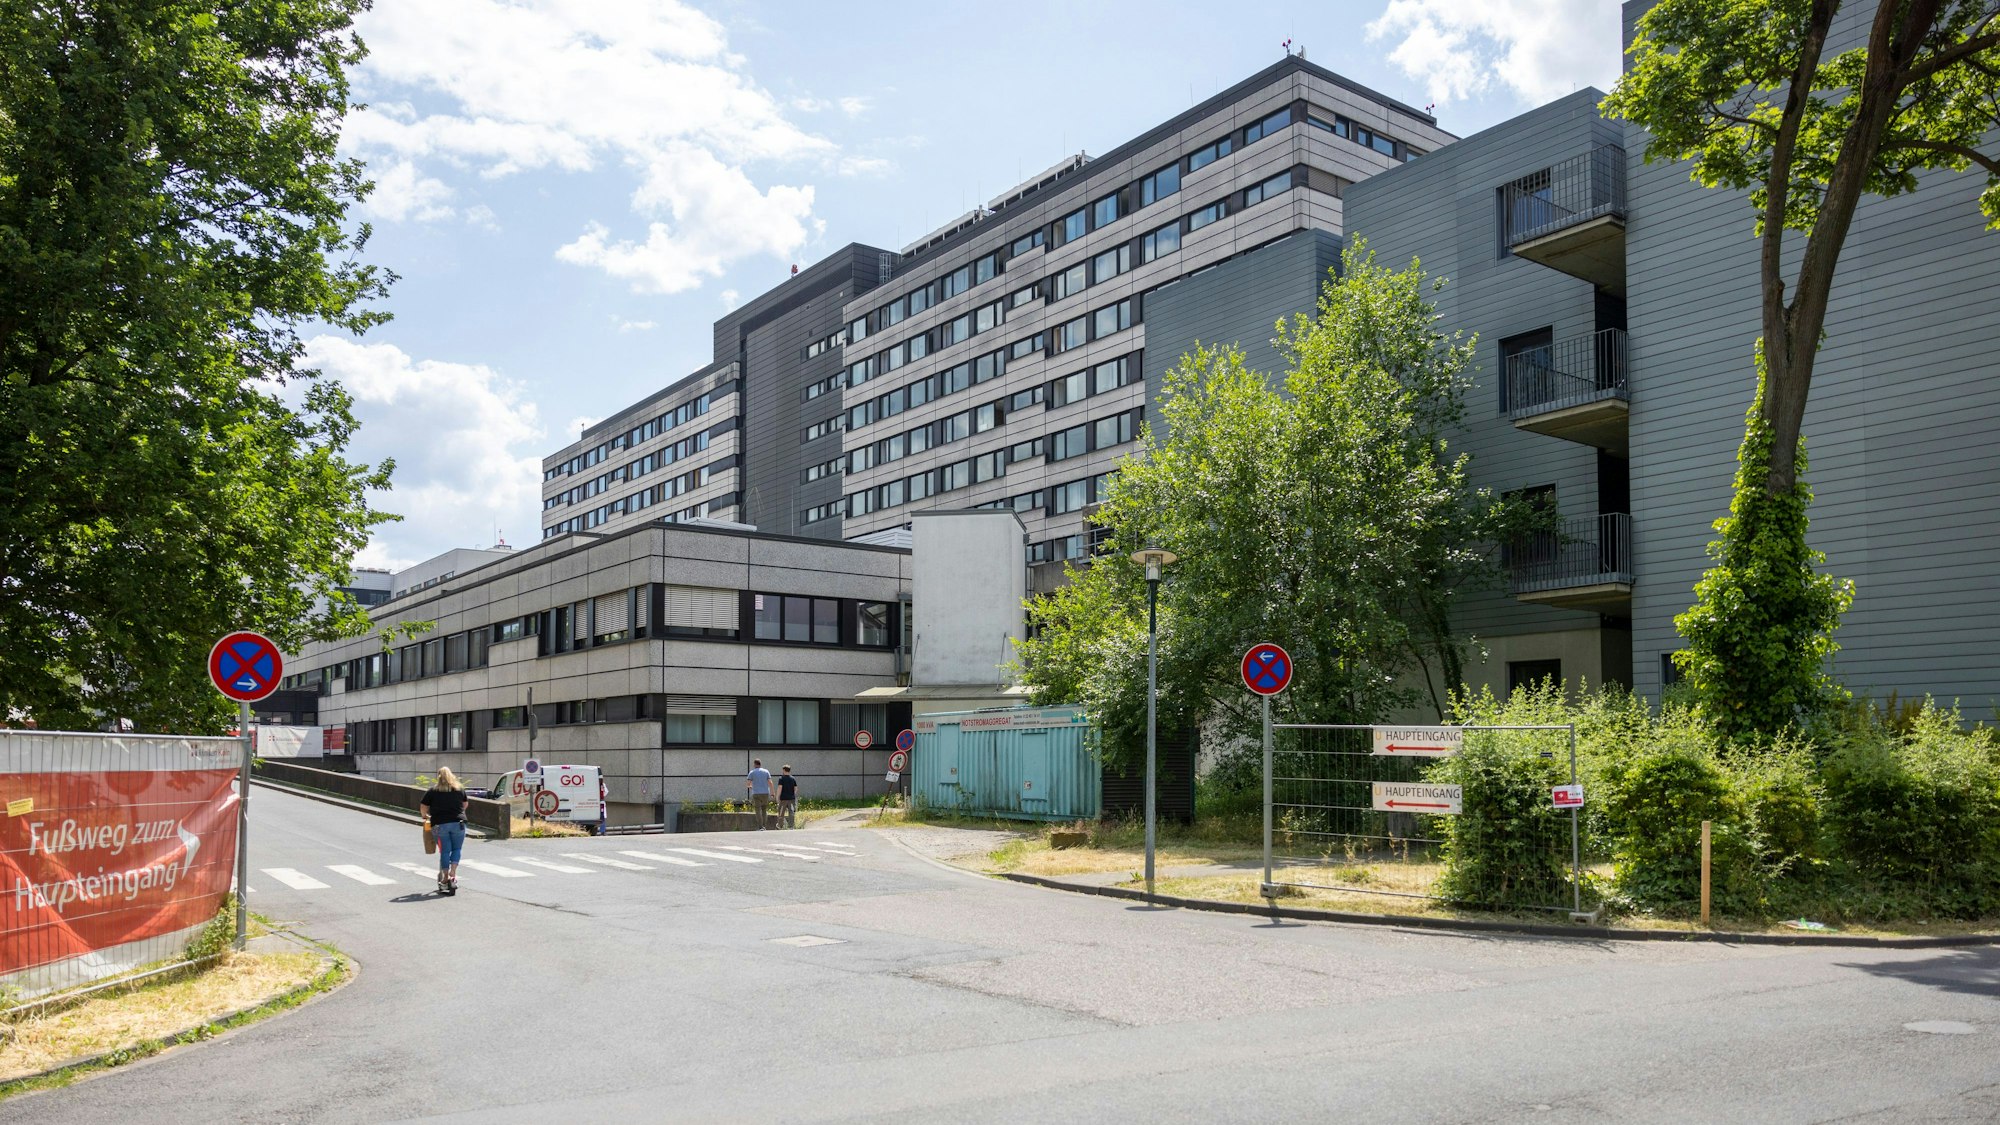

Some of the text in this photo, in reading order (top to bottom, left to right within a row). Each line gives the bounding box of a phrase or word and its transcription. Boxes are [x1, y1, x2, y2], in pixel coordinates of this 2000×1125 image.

[962, 717, 1011, 727] NOTSTROMAGGREGAT
[1386, 731, 1461, 741] HAUPTEINGANG
[560, 775, 584, 786] GO!
[1386, 787, 1460, 799] HAUPTEINGANG
[29, 819, 175, 856] Fußweg zum
[15, 861, 179, 913] Haupteingang
